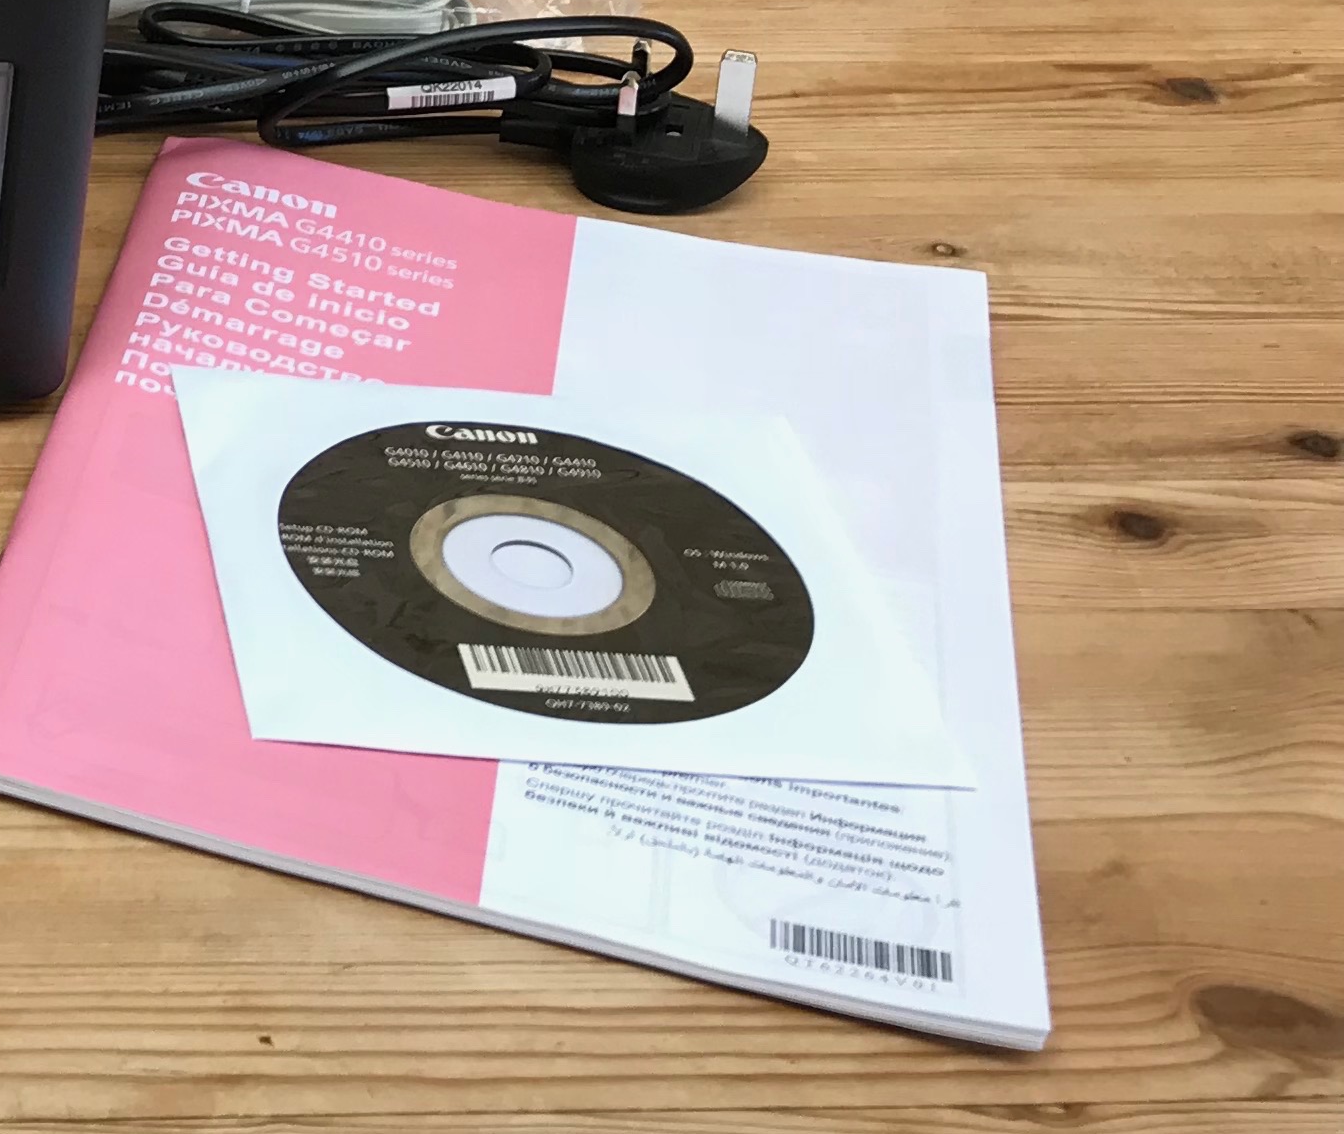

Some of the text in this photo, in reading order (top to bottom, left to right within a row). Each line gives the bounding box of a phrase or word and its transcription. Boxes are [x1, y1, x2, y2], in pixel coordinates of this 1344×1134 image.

[420, 80, 483, 93] QK22014
[186, 172, 337, 219] Canon
[170, 209, 455, 290] PIXMA G4510 series
[177, 191, 458, 270] PIXMA G4410 series
[164, 236, 441, 317] Getting Started
[252, 281, 295, 302] de
[142, 291, 345, 360] Démarrage
[150, 272, 413, 353] Para Começar
[425, 424, 539, 445] Canon
